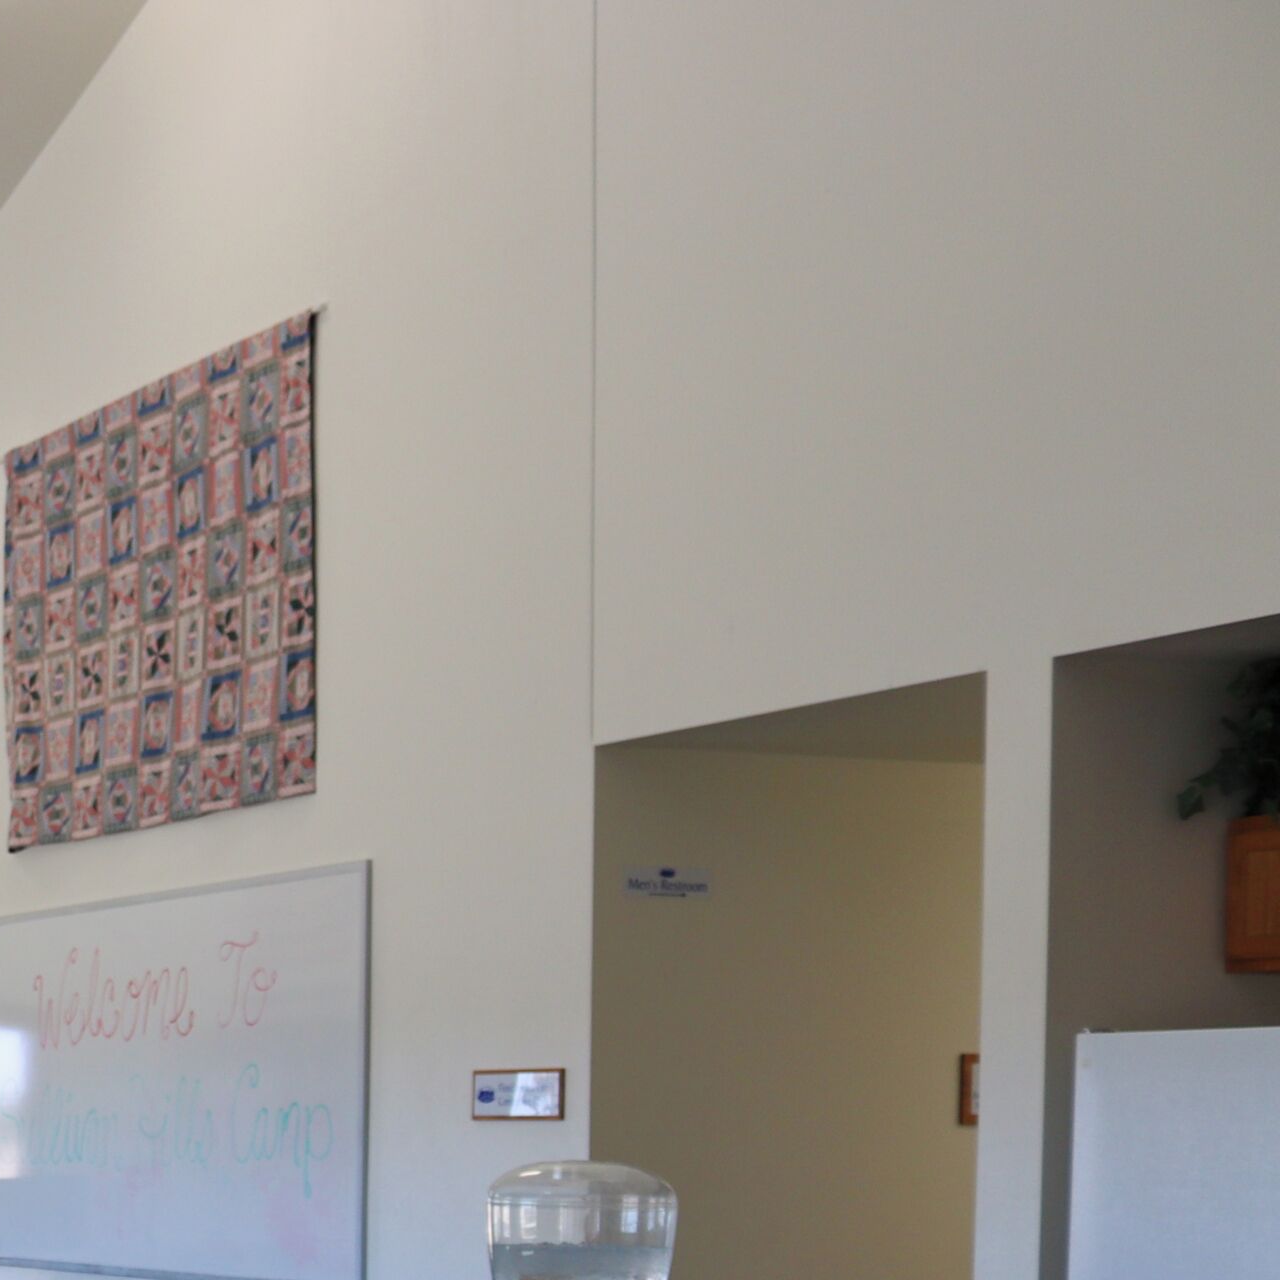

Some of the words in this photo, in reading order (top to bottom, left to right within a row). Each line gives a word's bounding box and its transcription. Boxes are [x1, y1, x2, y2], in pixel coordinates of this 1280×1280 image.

[628, 877, 658, 890] Men's
[661, 880, 708, 893] Restroom
[32, 946, 196, 1051] Welcome
[217, 930, 278, 1029] To
[232, 1062, 335, 1199] Camp
